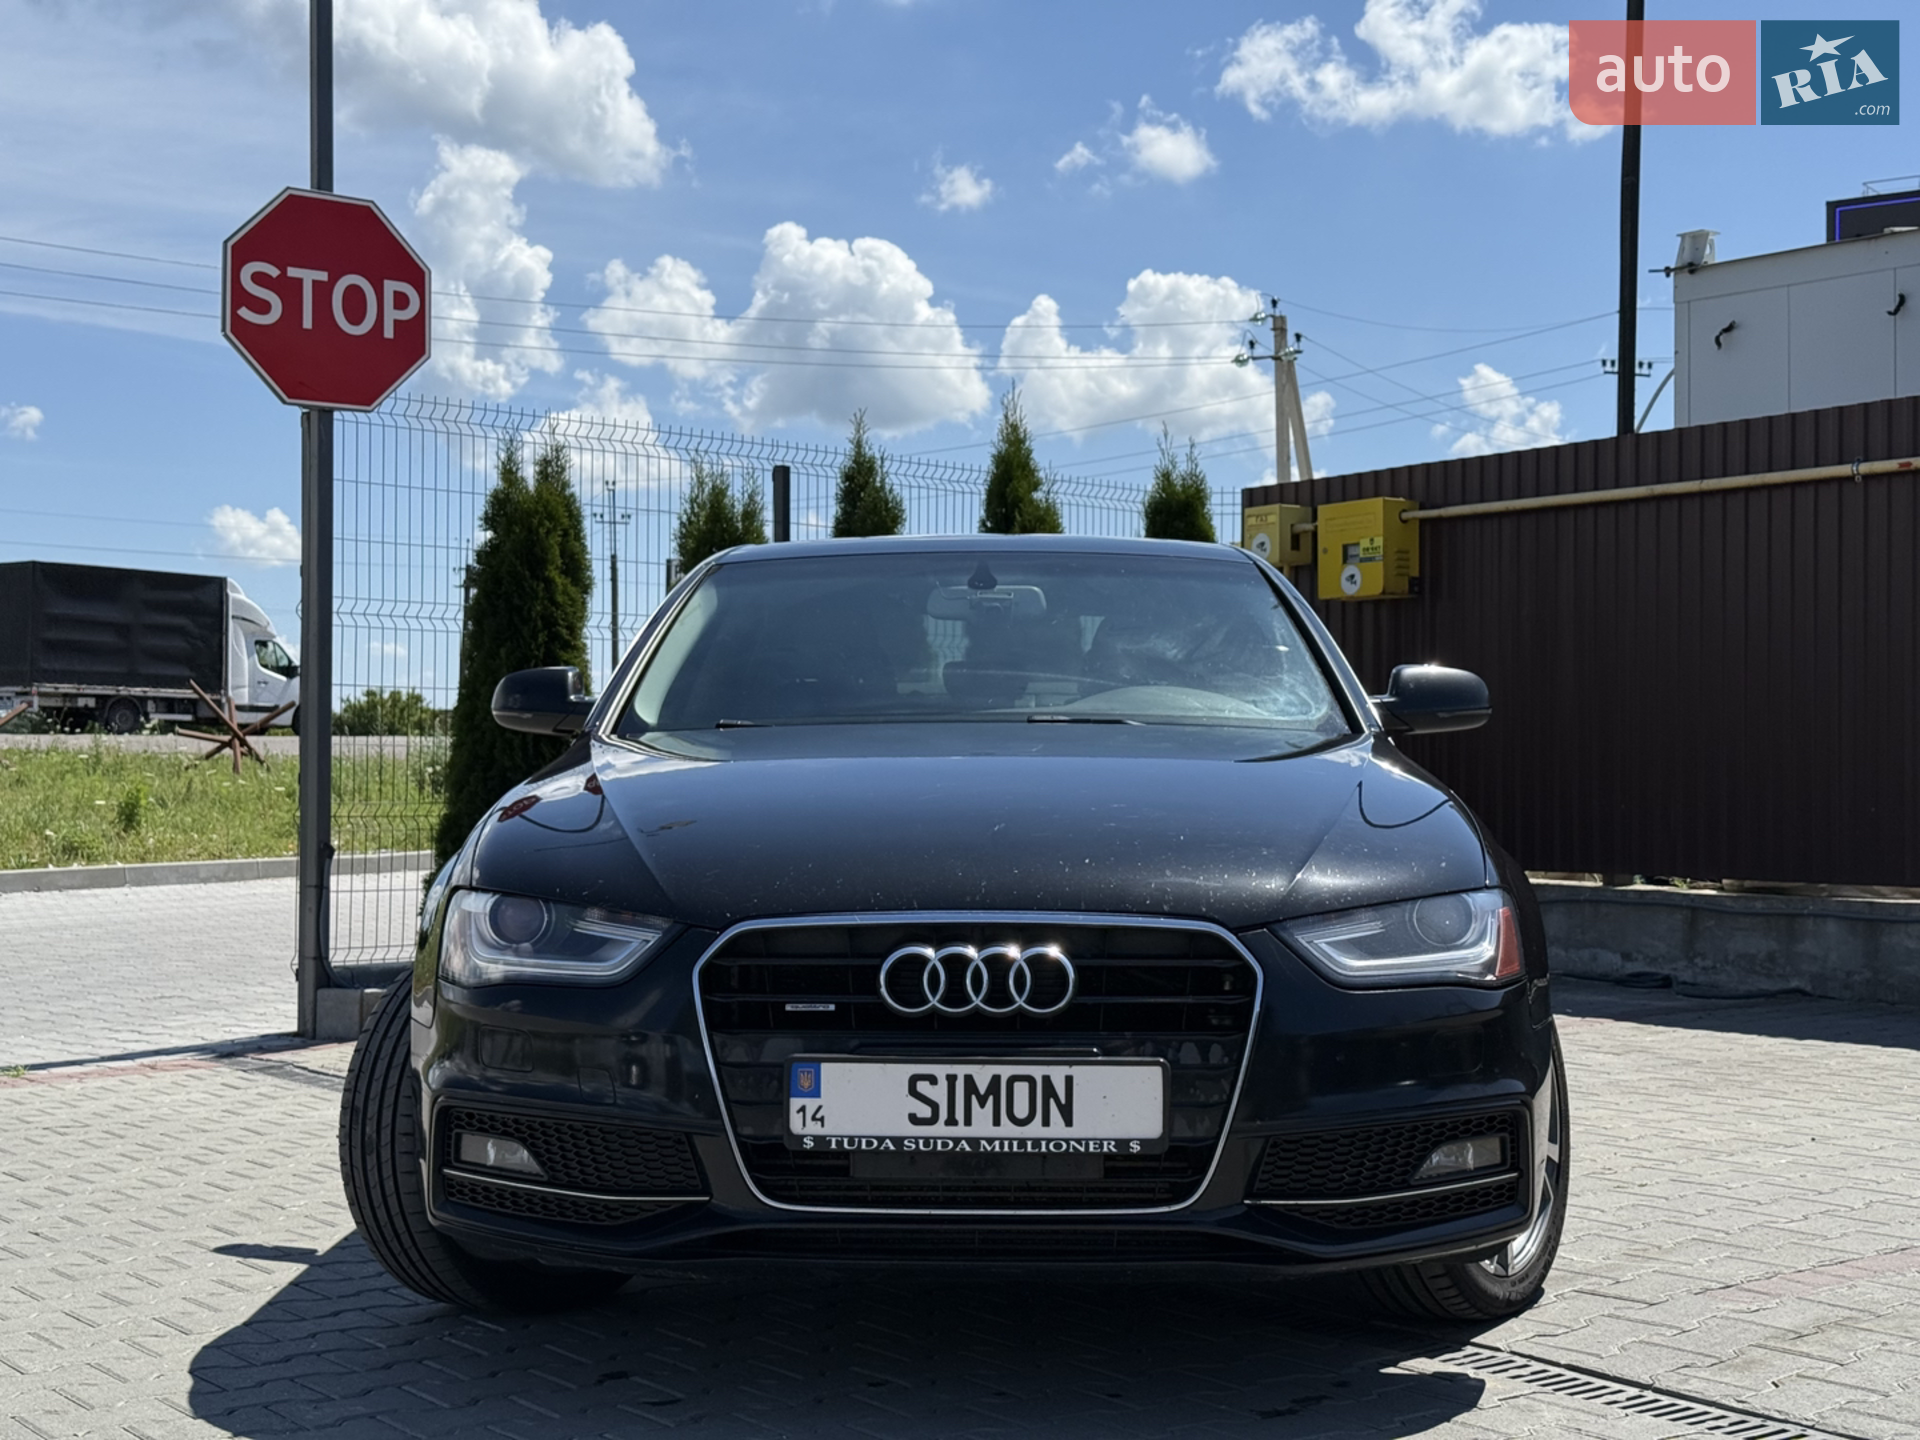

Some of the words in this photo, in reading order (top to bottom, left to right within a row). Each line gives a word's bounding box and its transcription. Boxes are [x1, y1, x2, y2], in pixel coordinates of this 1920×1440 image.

[236, 261, 421, 339] STOP
[796, 1104, 825, 1128] 14
[907, 1073, 1074, 1128] SIMON
[826, 1136, 896, 1151] TUDA
[903, 1138, 973, 1152] SUDA
[979, 1139, 1118, 1153] MILLIONER
